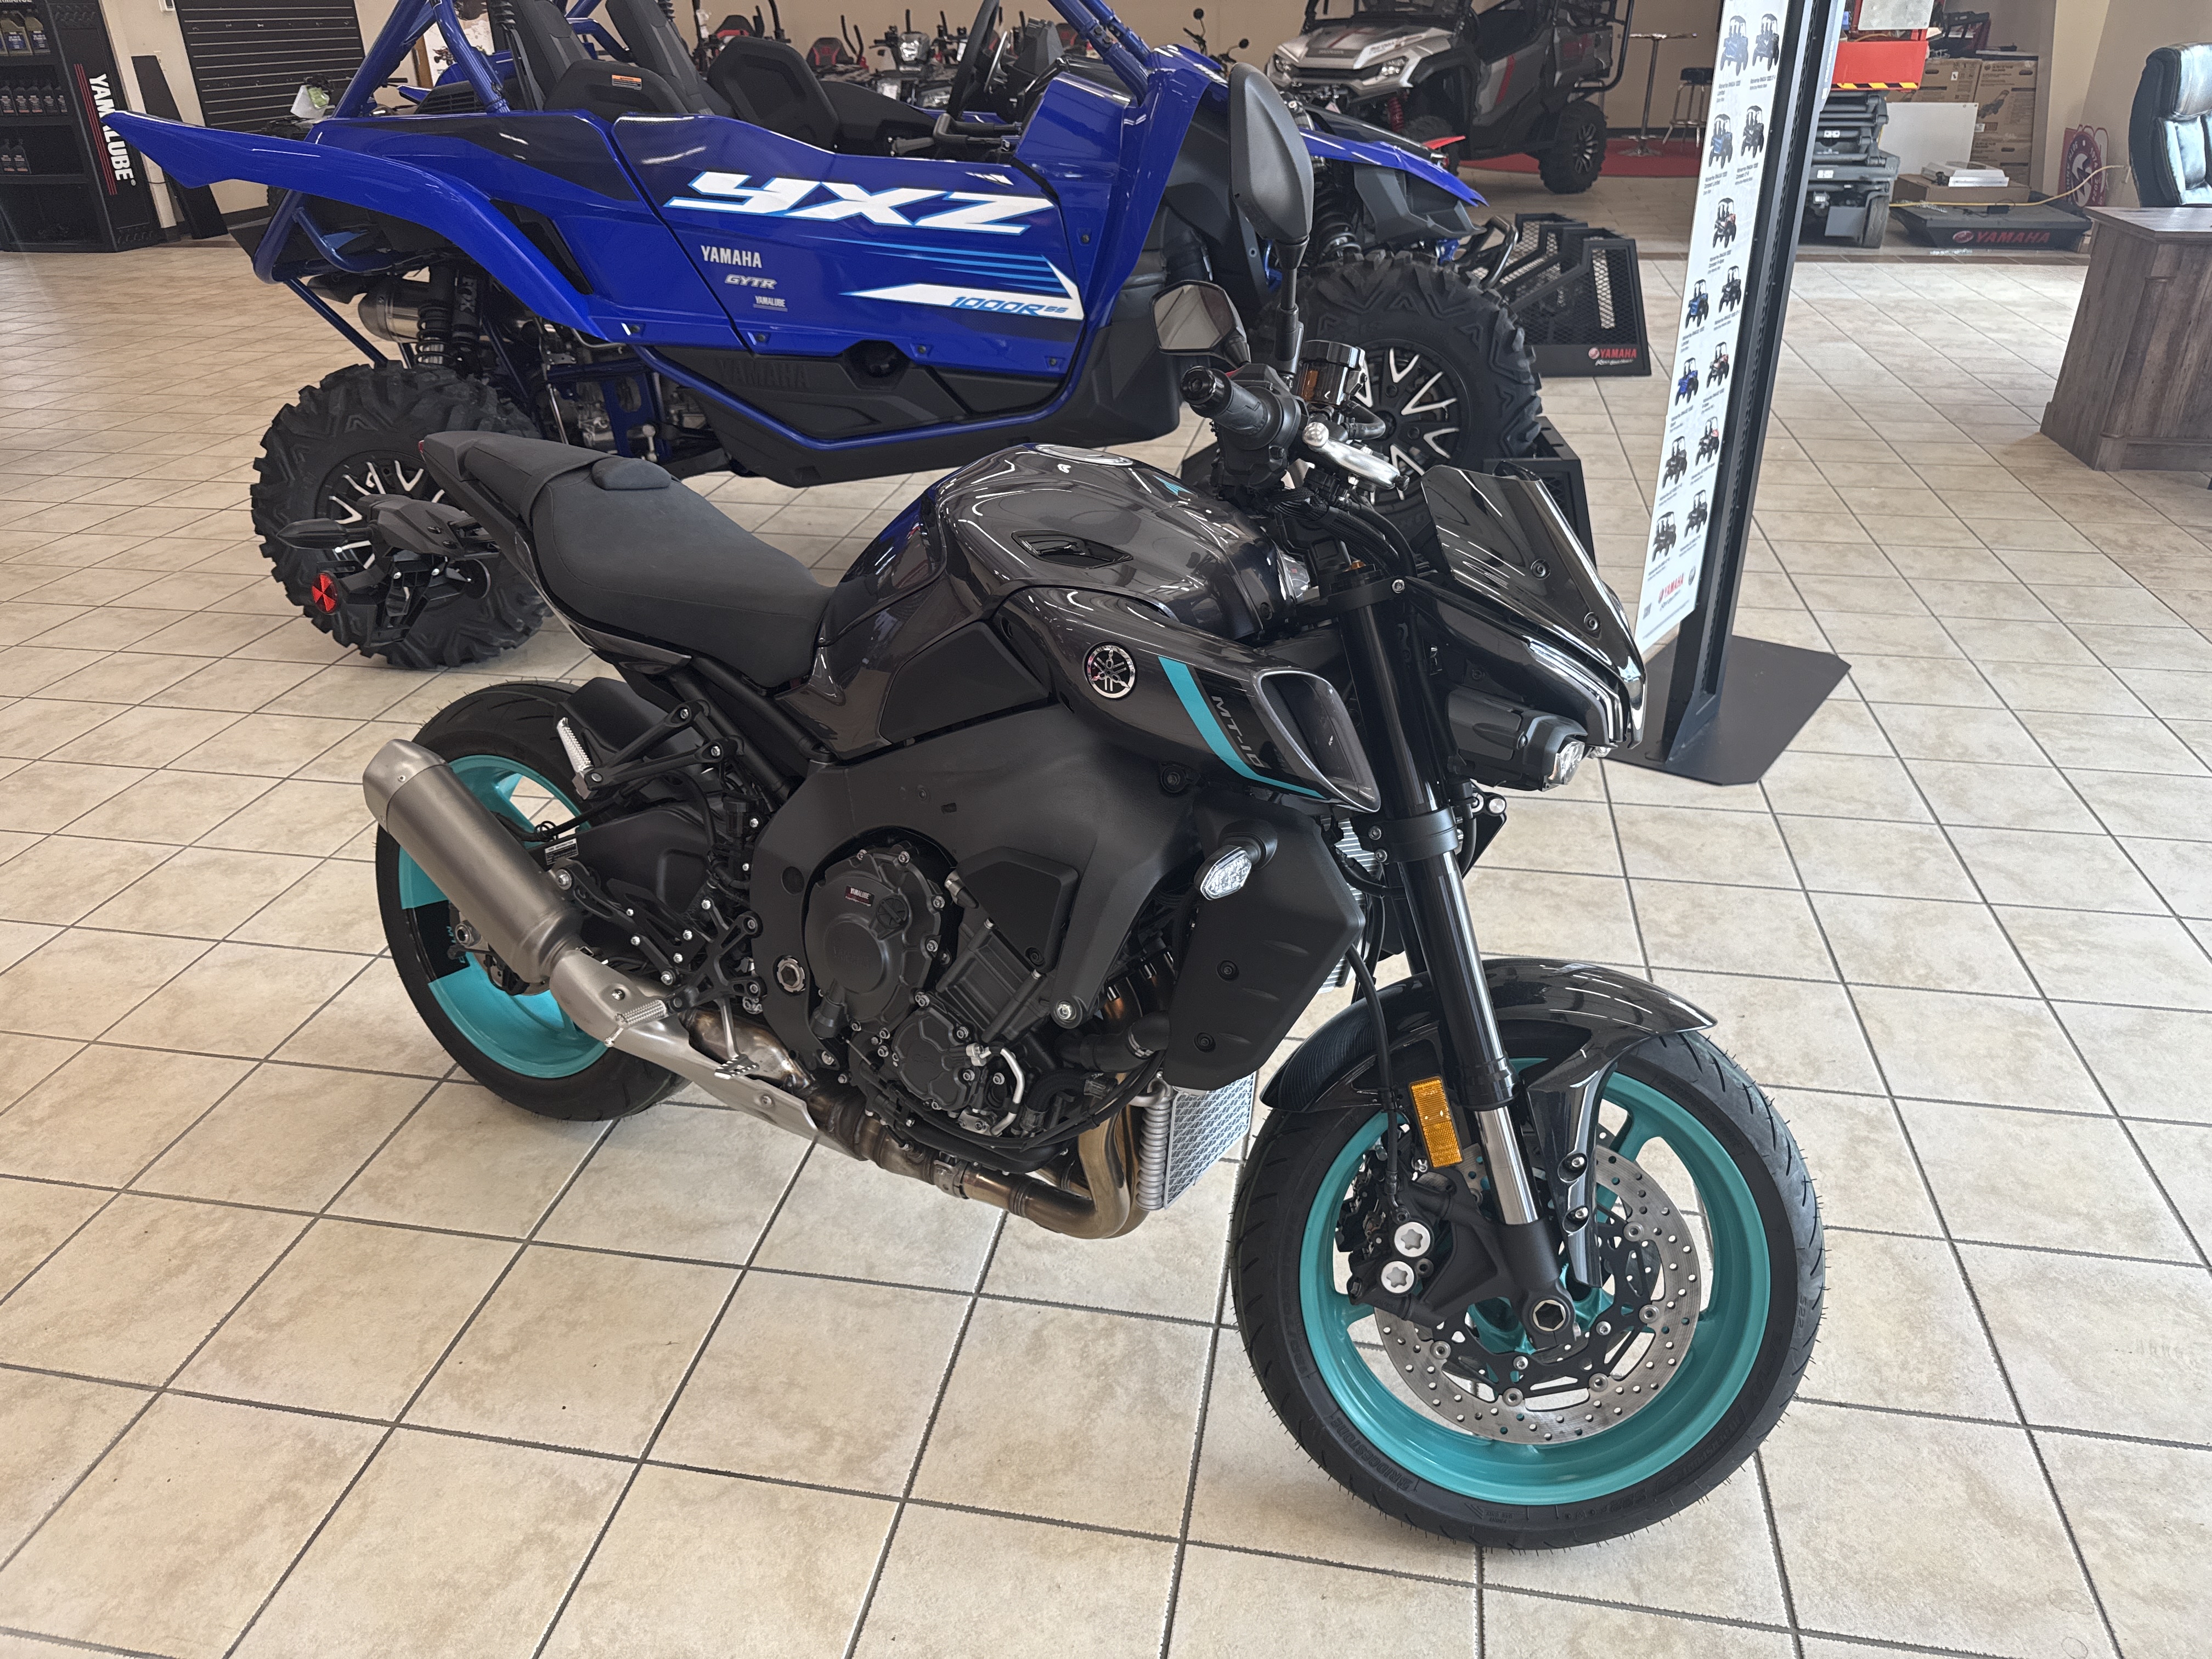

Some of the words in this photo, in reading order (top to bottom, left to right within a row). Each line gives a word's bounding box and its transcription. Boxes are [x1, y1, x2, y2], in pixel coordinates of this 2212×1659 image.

[89, 74, 134, 180] YAMLUBE
[663, 171, 1054, 236] YXZ
[1977, 232, 2051, 243] YAMAHA
[701, 245, 762, 268] YAMAHA
[725, 274, 777, 290] GYTR
[460, 276, 477, 314] FOX
[754, 295, 786, 308] YAMALUBE
[950, 296, 1046, 316] 1000R
[1600, 348, 1637, 359] YAMAHA
[1211, 696, 1266, 768] MT-10
[850, 887, 871, 900] YAMALUBE
[1328, 1417, 1413, 1491] BRIDGESTONE
